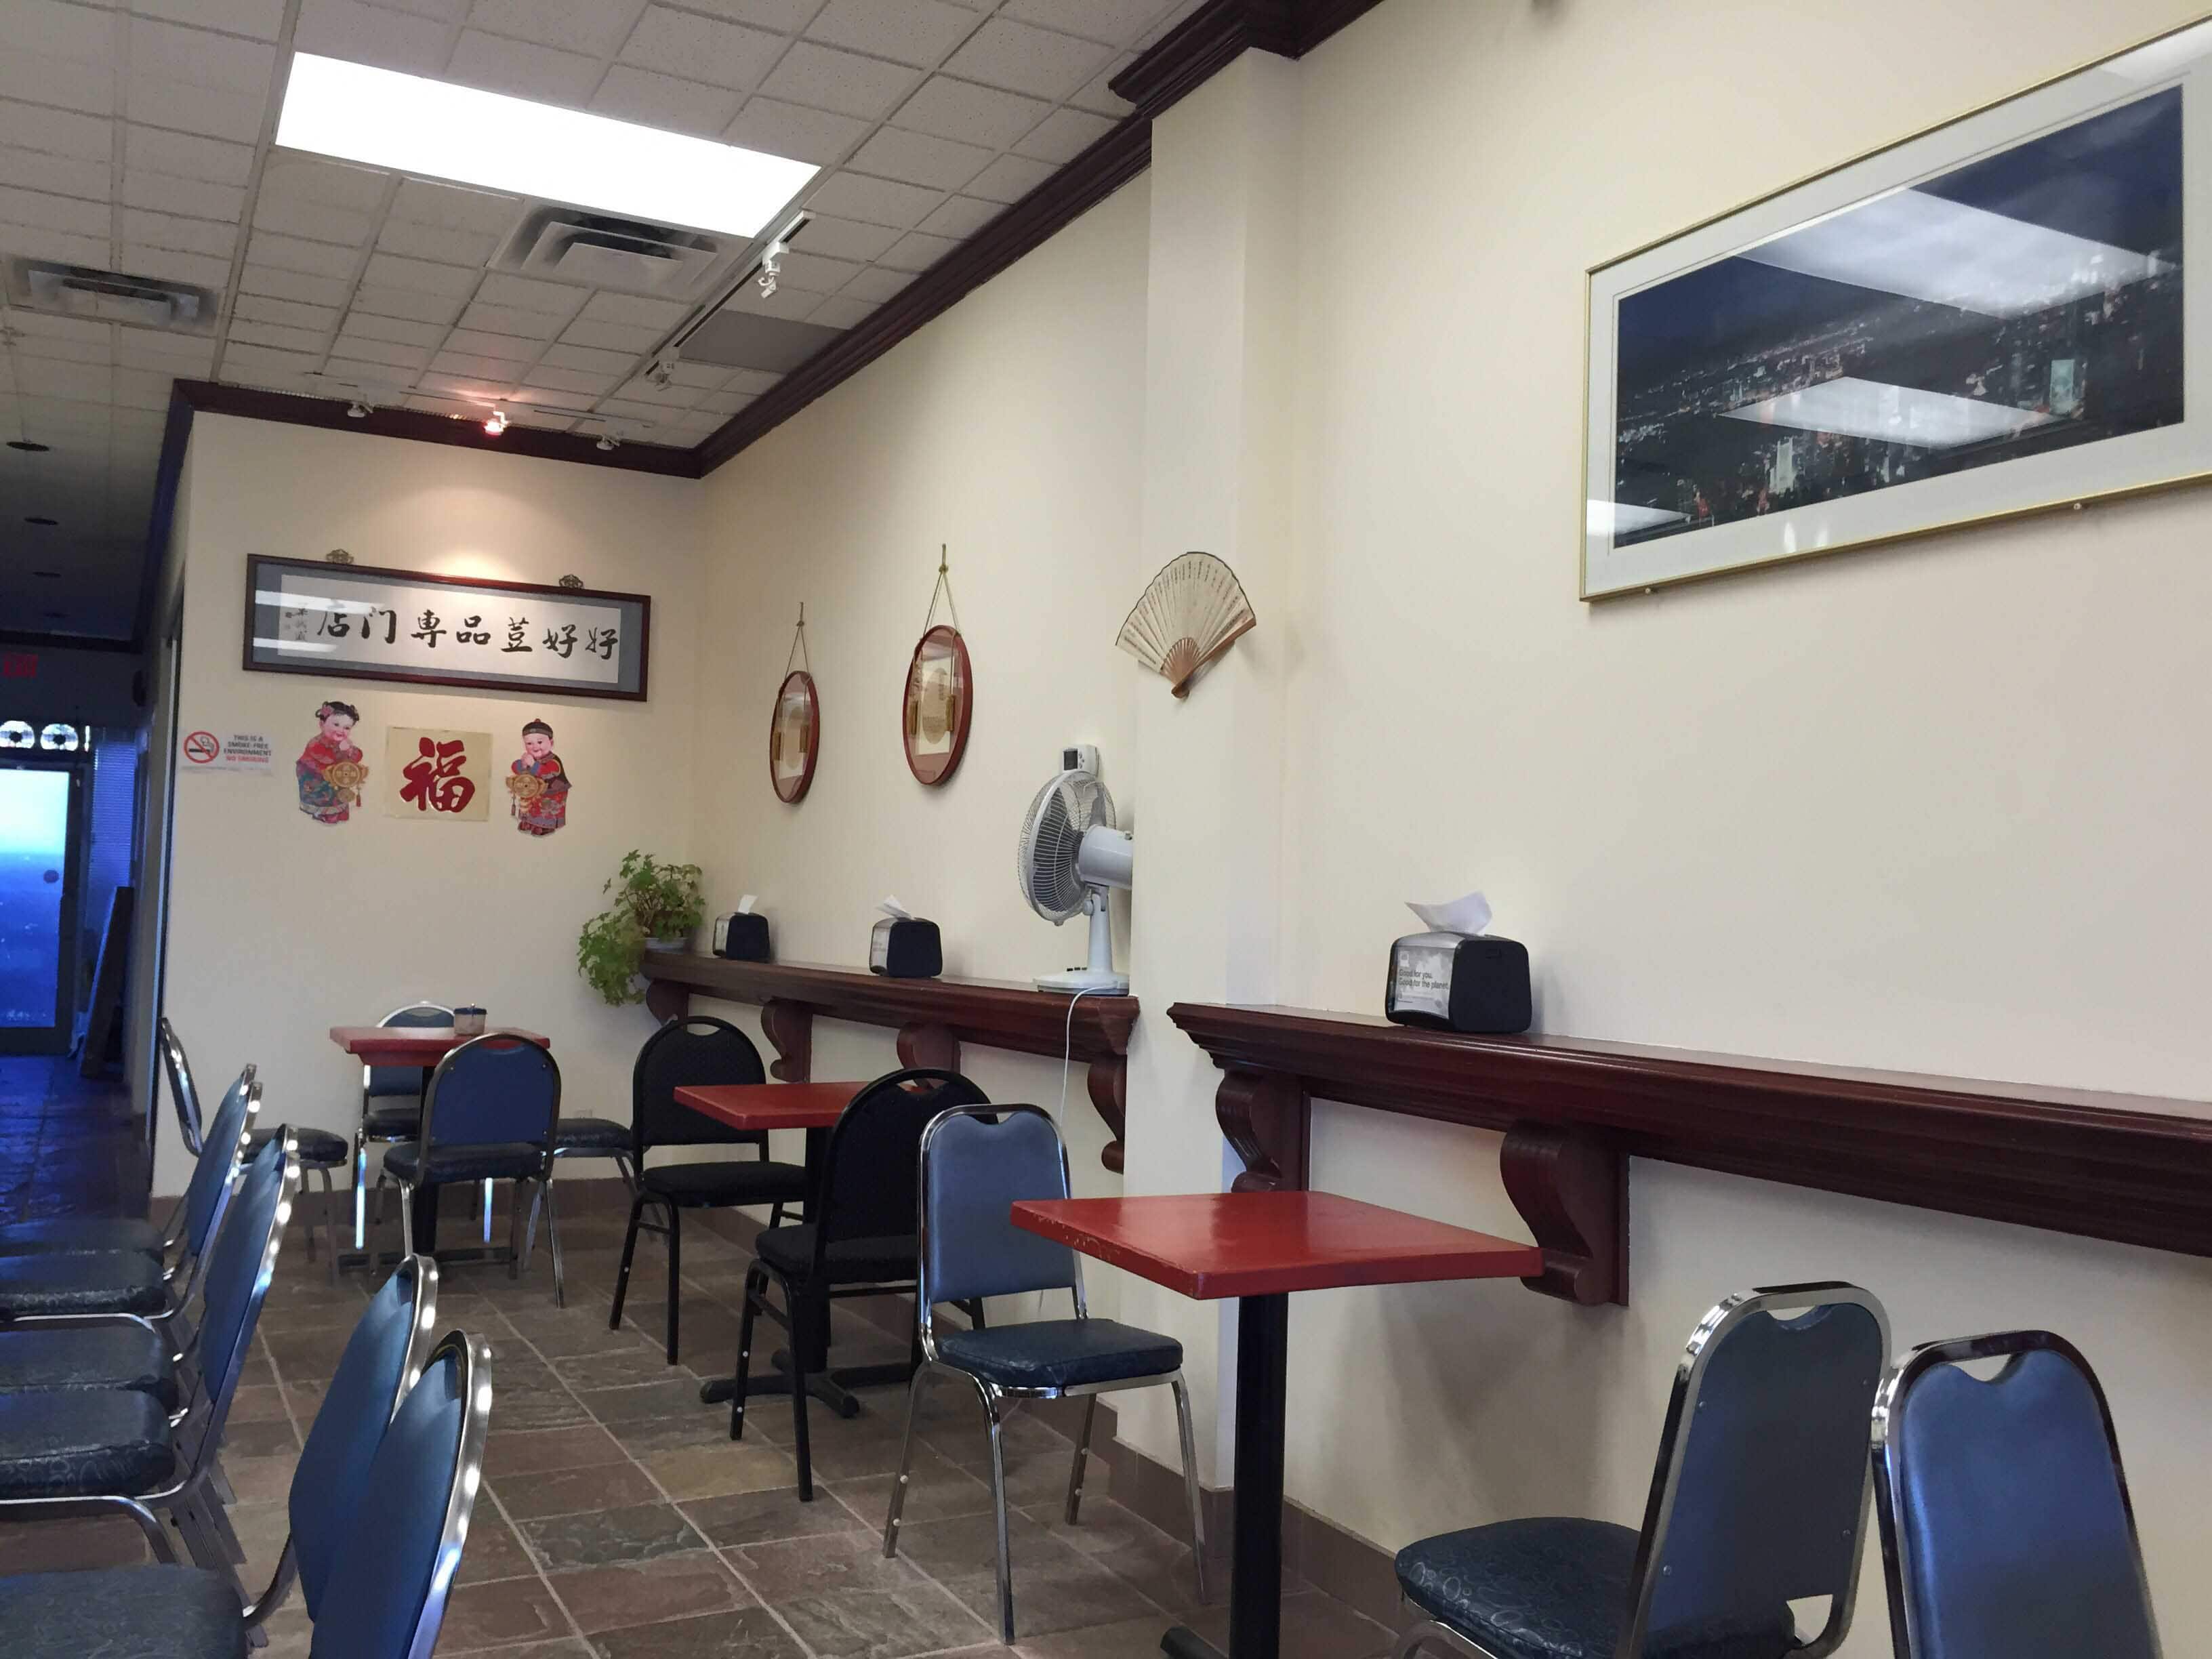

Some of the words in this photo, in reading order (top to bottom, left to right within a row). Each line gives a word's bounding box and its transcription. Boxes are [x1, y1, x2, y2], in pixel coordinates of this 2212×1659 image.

[400, 737, 475, 813] 福
[1398, 978, 1412, 987] Good
[1422, 980, 1430, 988] the
